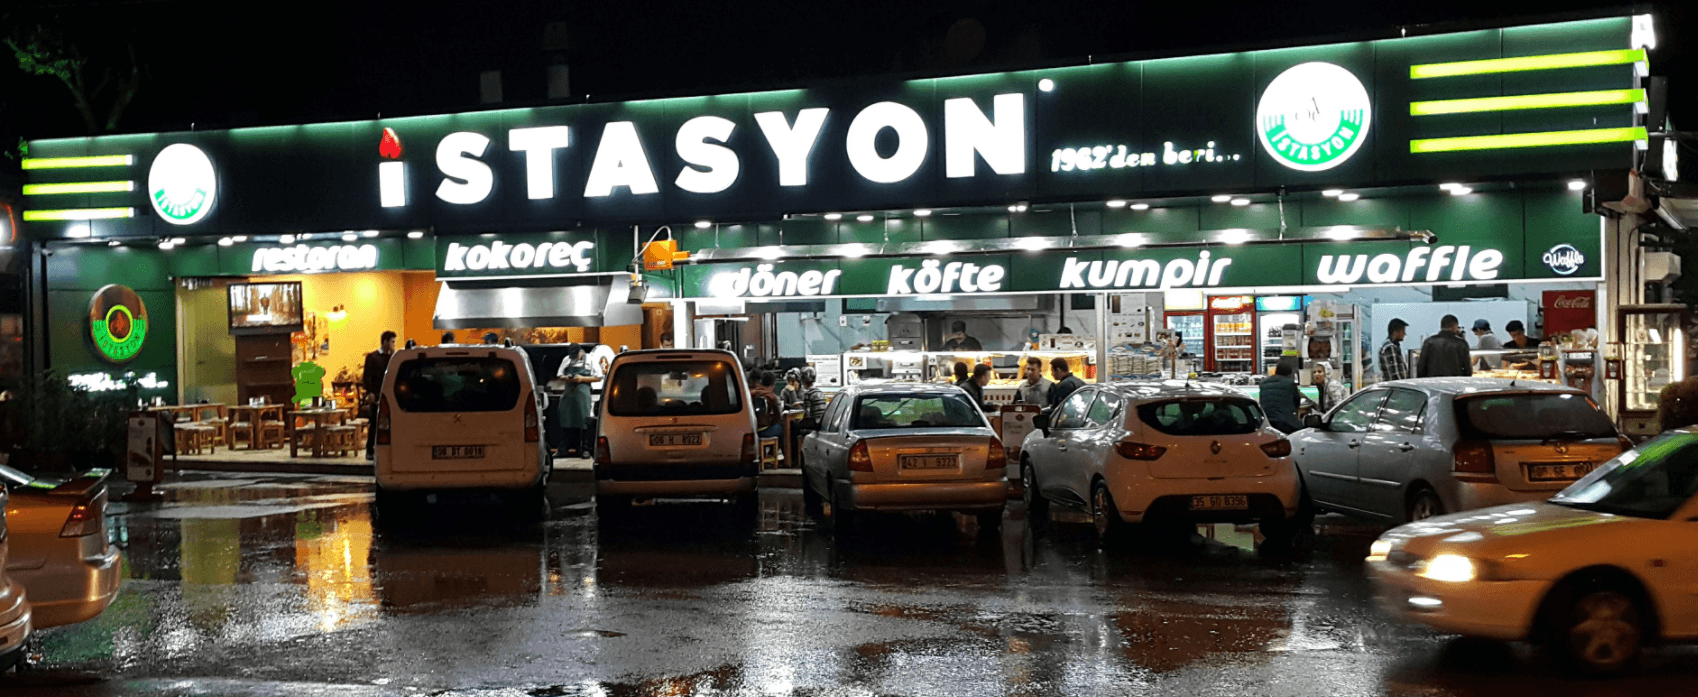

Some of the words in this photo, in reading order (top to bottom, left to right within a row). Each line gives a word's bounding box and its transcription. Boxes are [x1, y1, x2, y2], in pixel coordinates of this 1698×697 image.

[251, 243, 379, 273] restoran
[444, 240, 595, 273] kokoreç
[1059, 250, 1233, 290] kumpir
[1316, 245, 1504, 284] waffle
[1542, 250, 1585, 269] Waffle
[886, 259, 1006, 296] köfte
